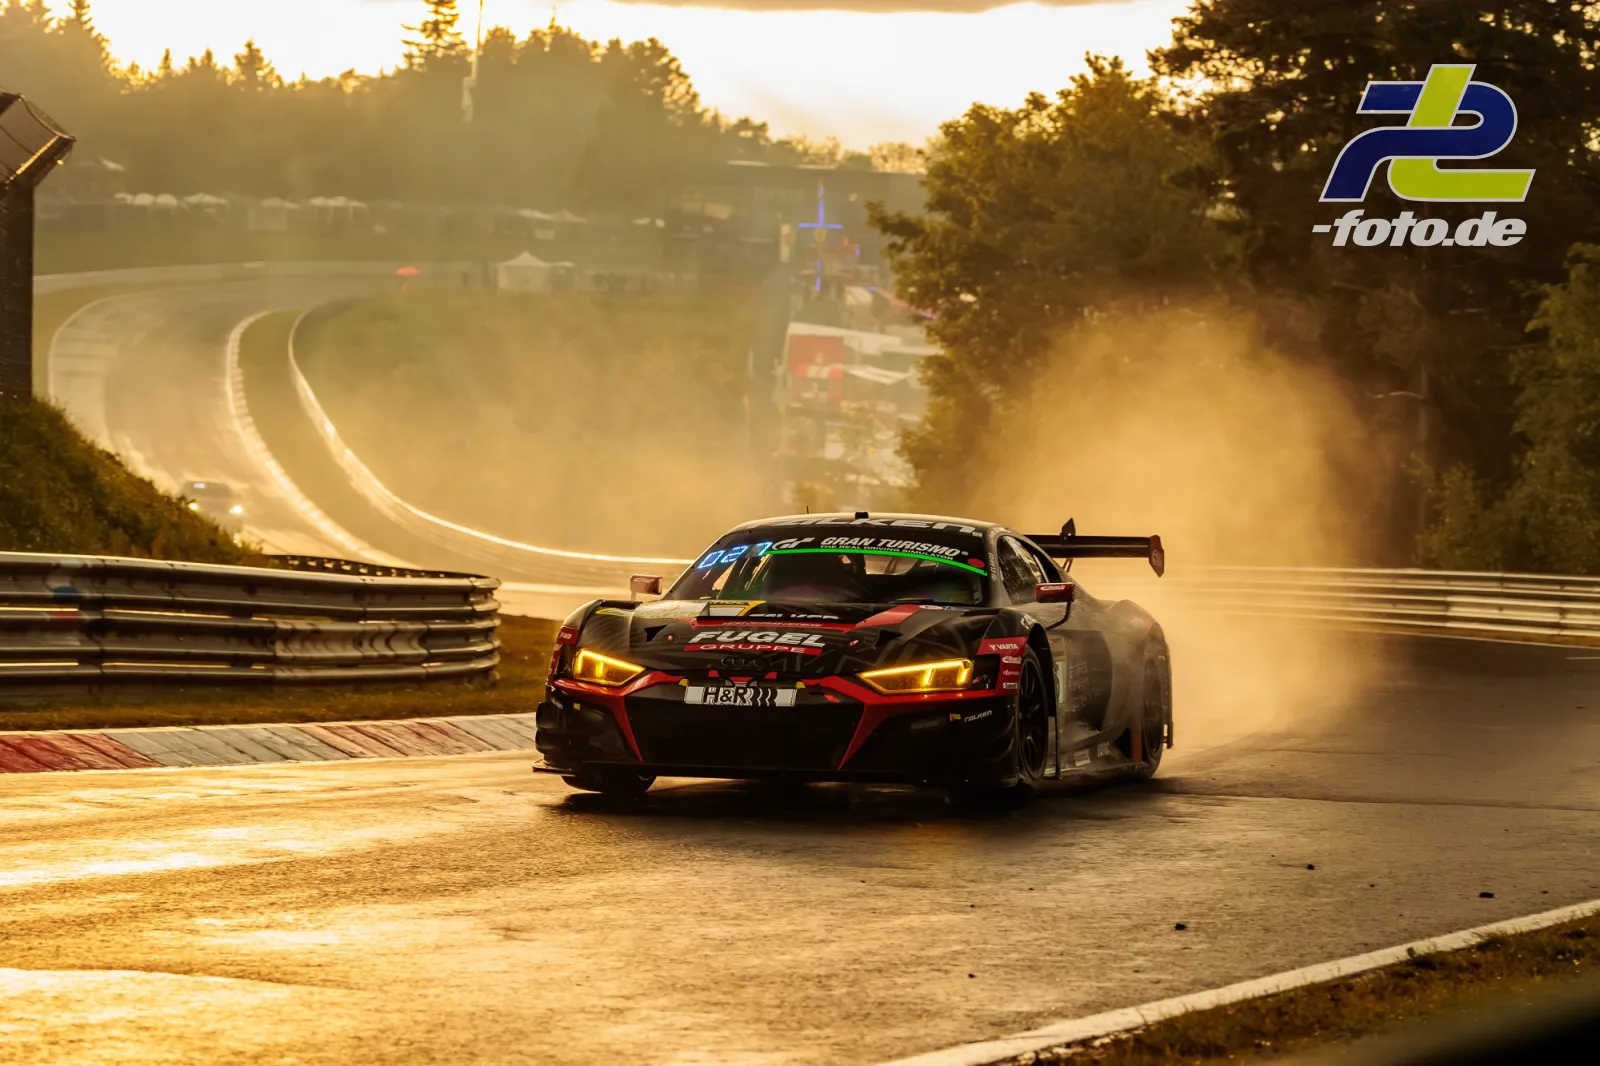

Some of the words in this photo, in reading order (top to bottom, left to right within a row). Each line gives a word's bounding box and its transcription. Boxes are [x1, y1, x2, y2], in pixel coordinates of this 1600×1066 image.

[697, 541, 773, 569] 027
[820, 537, 876, 546] GRAN
[877, 539, 961, 557] TURISMO
[902, 549, 953, 560] SIMULATOR
[688, 630, 826, 648] FUGEL
[700, 644, 806, 654] GRUPPE
[701, 686, 748, 704] H&R
